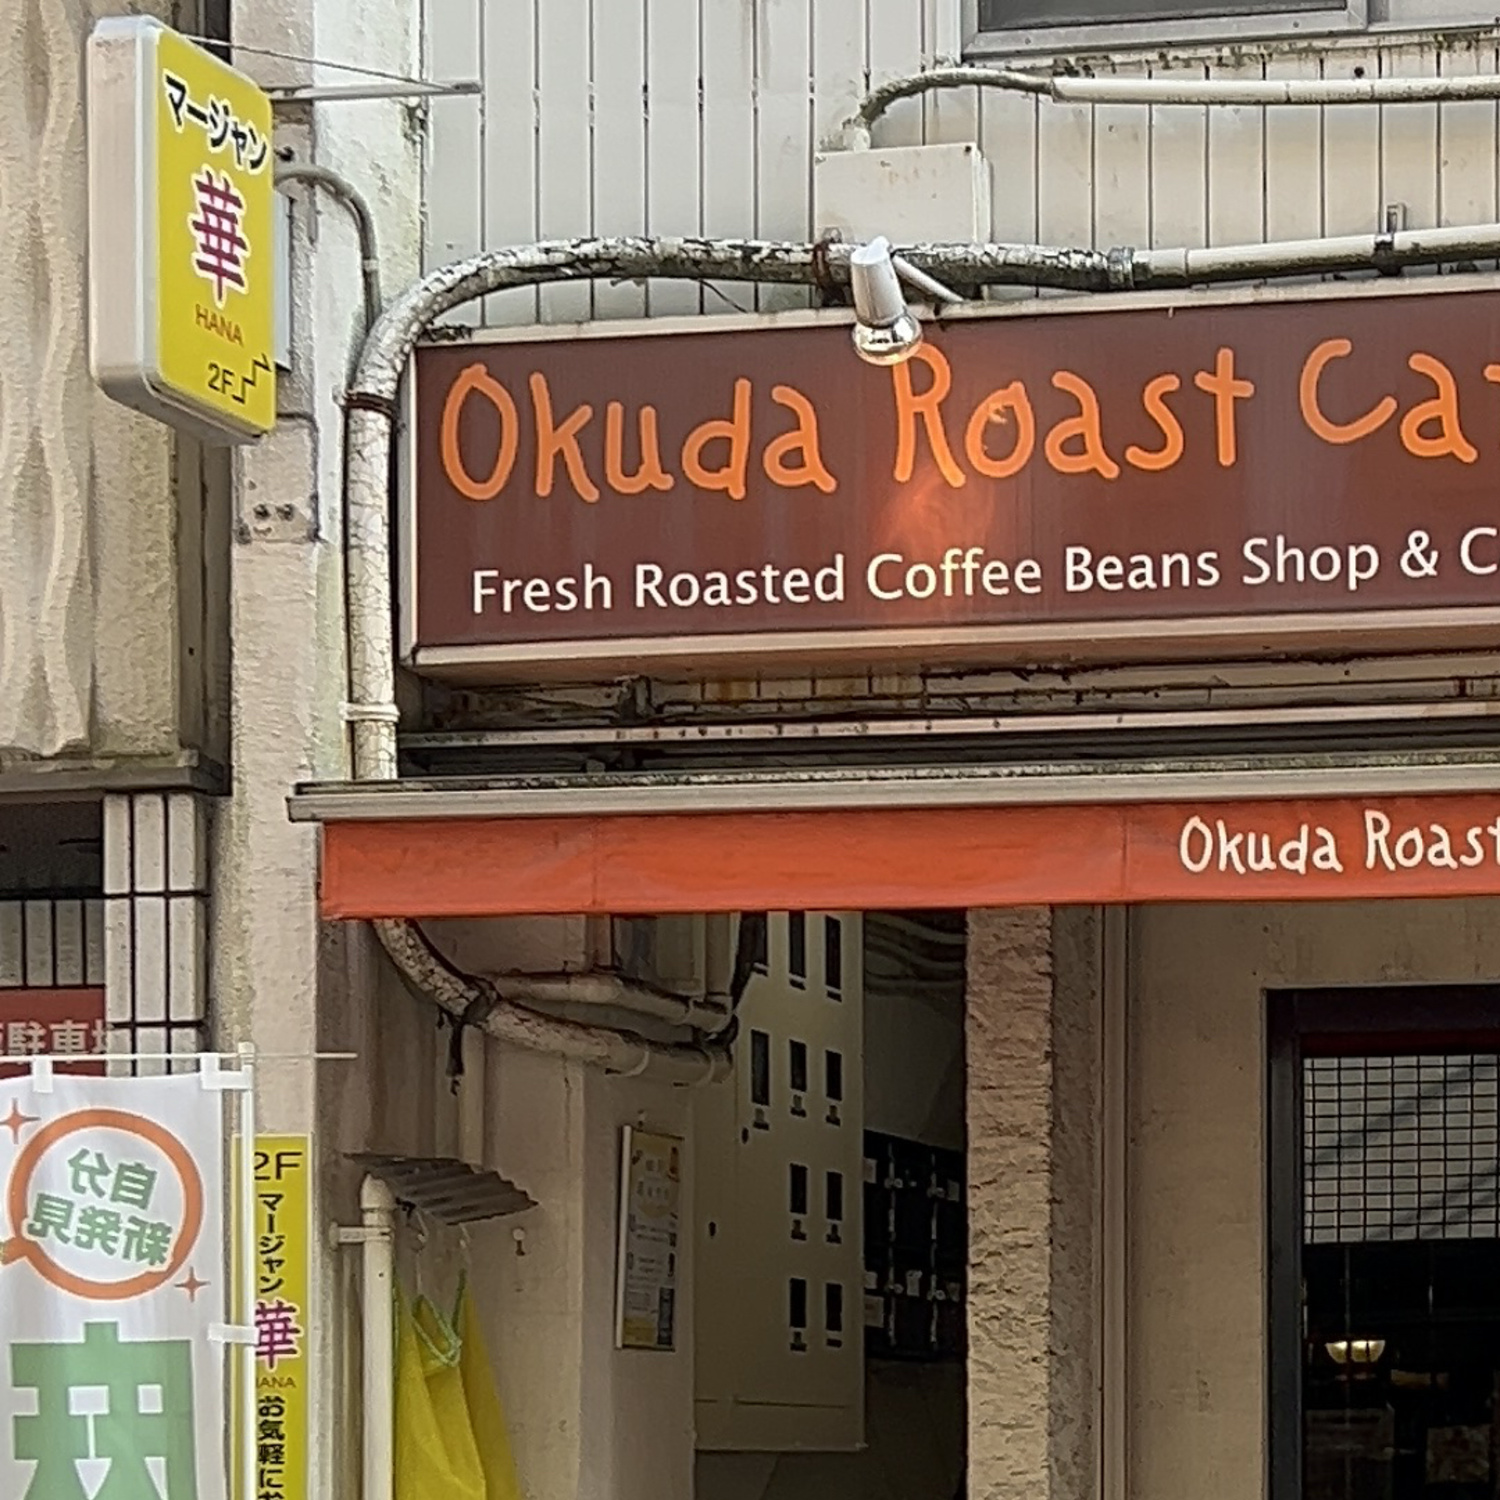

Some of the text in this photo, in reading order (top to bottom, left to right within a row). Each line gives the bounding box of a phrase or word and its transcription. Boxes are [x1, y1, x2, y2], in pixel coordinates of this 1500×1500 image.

[163, 73, 267, 169] マージャン
[191, 169, 249, 303] 華
[194, 304, 244, 347] HANA
[206, 362, 235, 395] 2F
[440, 363, 837, 502] Okuda
[893, 341, 1255, 487] Roast
[473, 563, 612, 613] Fresh
[635, 553, 845, 608] Roasted
[866, 547, 1042, 600] Coffee
[1065, 545, 1220, 593] Beans
[1242, 534, 1379, 590] Shop
[1399, 529, 1439, 578] &
[1179, 815, 1344, 875] Okuda
[0, 1018, 107, 1063] 駐車
[258, 1193, 285, 1294] マージャン
[255, 1300, 302, 1371] 華
[256, 1375, 297, 1389] ANA
